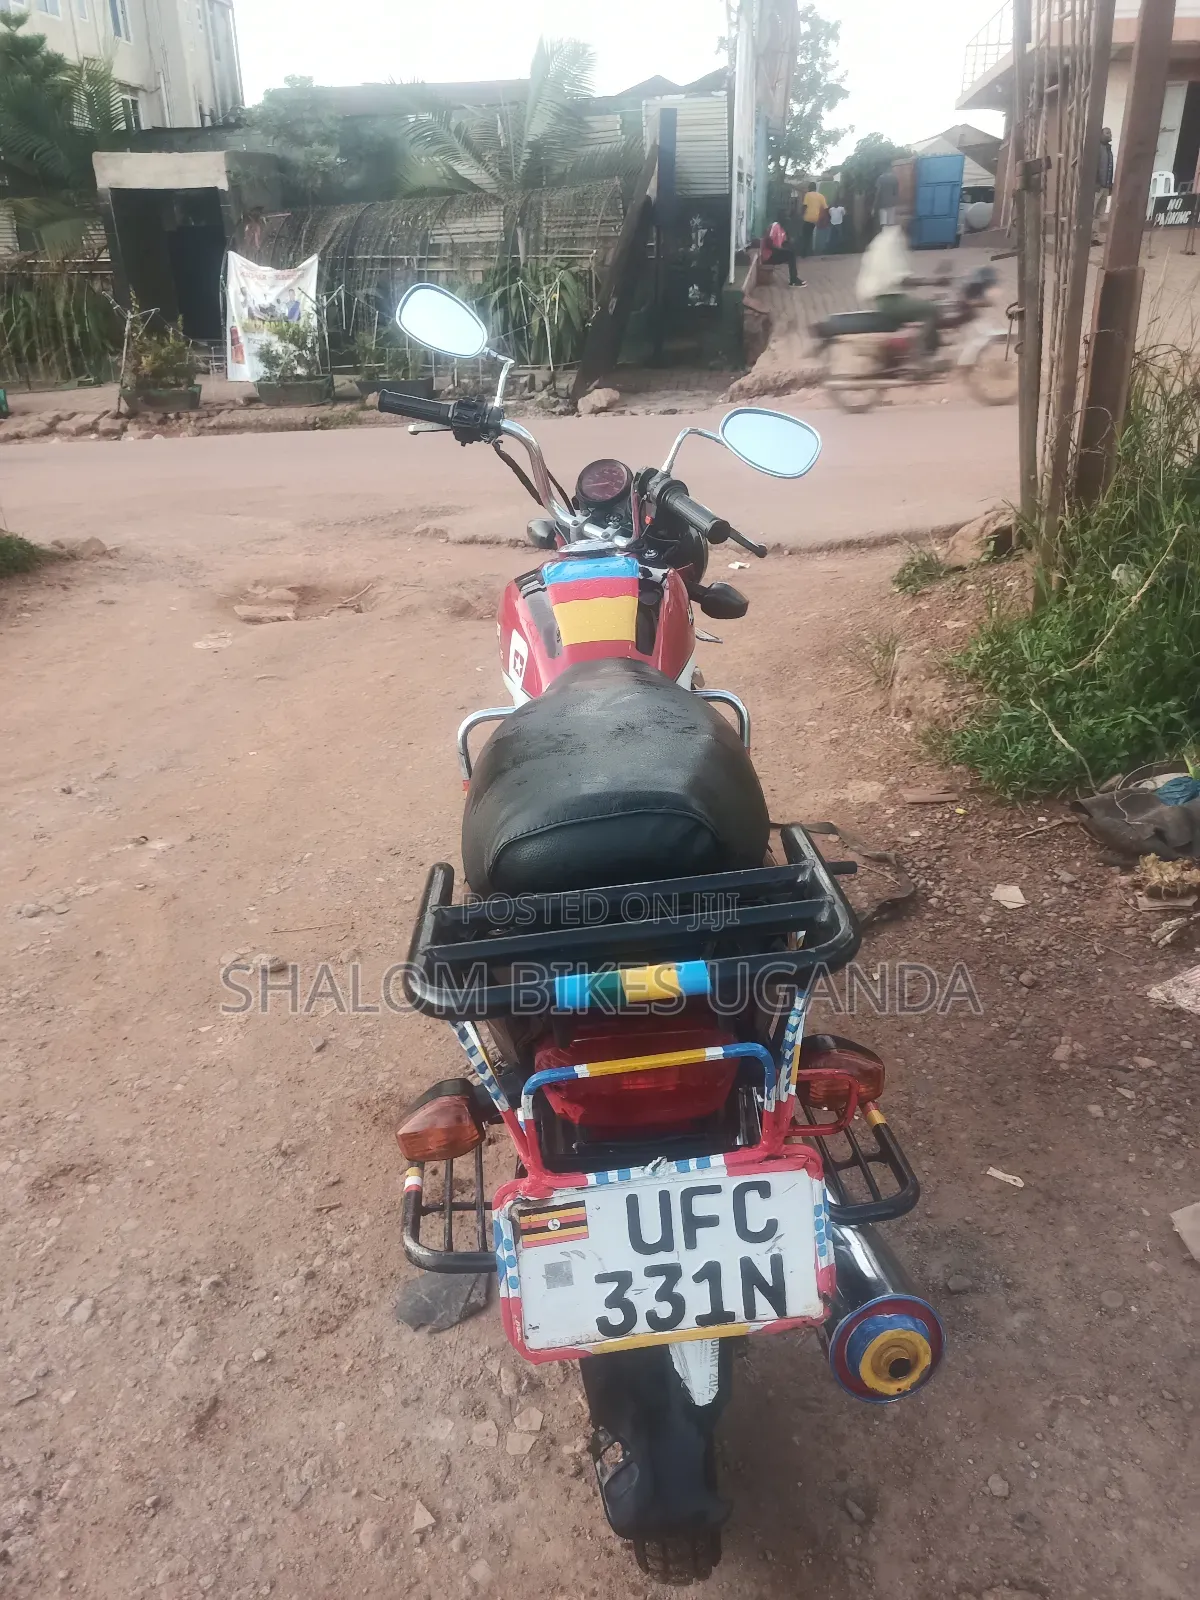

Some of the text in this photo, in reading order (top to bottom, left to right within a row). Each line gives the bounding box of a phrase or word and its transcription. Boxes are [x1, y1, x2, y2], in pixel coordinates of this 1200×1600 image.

[1154, 210, 1192, 226] PARKING
[1167, 198, 1183, 210] NO
[625, 1180, 779, 1256] UFC
[594, 1253, 788, 1338] 331N
